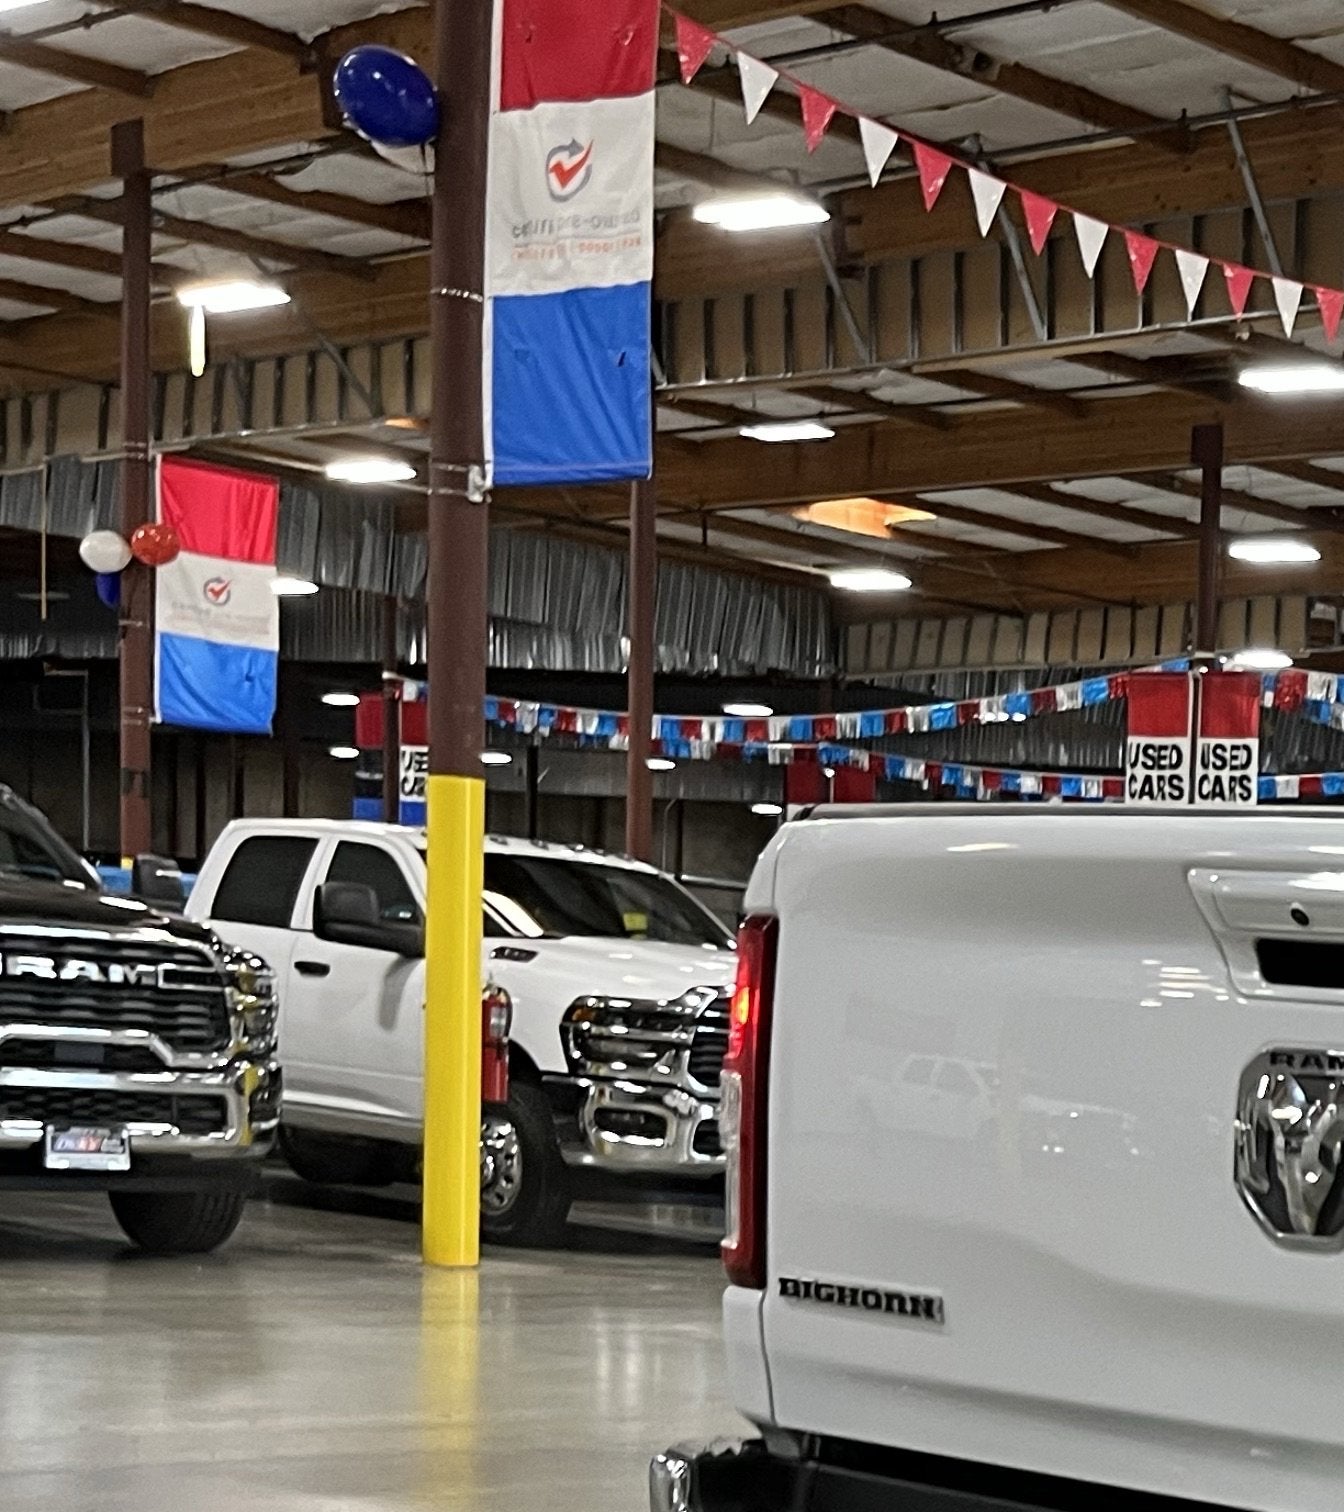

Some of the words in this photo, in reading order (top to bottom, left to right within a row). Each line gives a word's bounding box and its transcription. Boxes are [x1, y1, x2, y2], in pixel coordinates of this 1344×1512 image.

[1129, 743, 1183, 771] USED
[1200, 743, 1252, 771] USED
[1128, 773, 1184, 801] CARS
[1198, 773, 1252, 801] CARS
[6, 955, 157, 986] RAM
